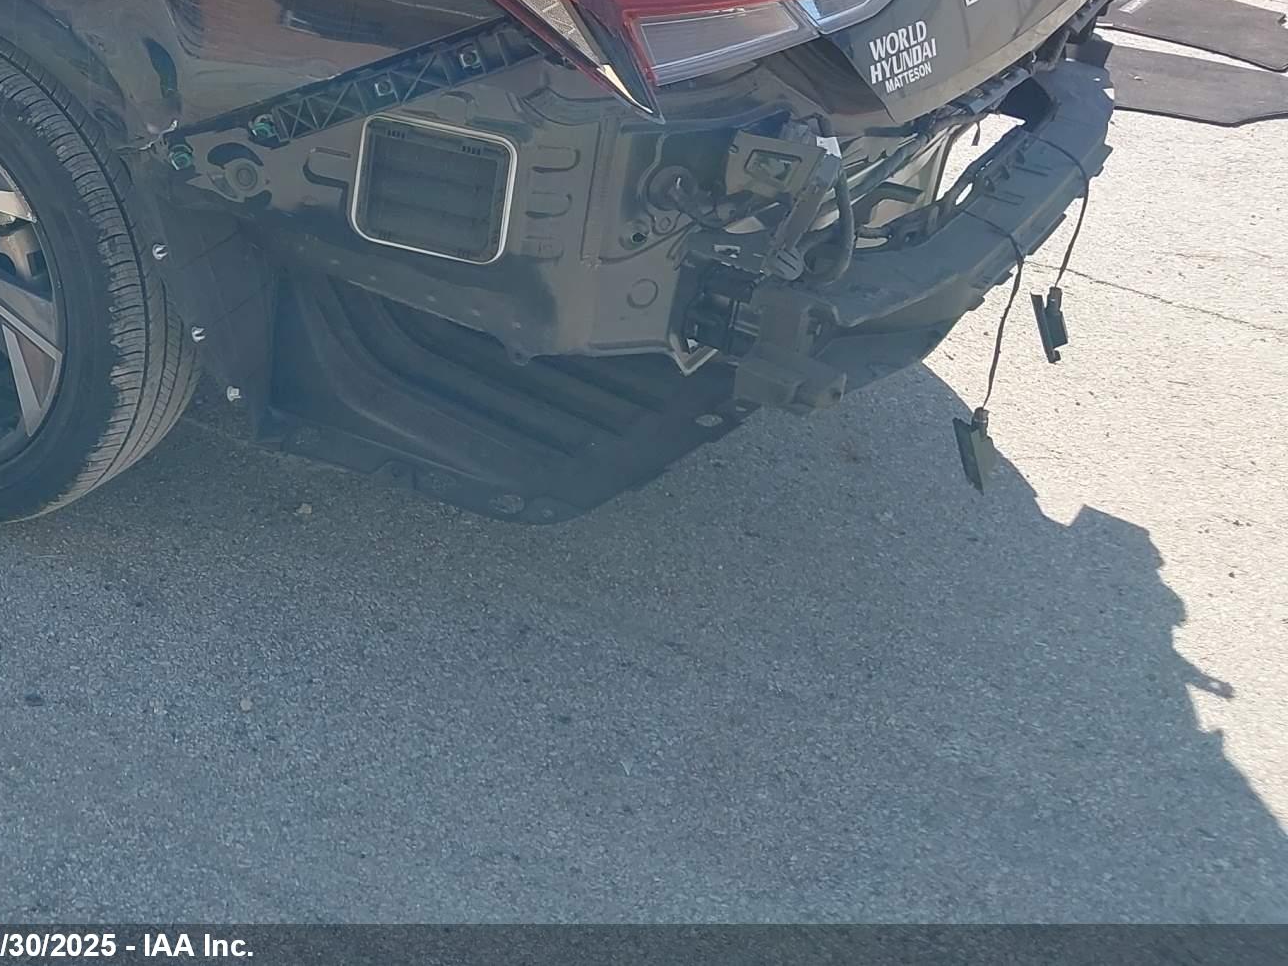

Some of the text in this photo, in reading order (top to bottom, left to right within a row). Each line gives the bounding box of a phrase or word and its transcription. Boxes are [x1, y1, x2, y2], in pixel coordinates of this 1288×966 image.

[869, 20, 927, 61] WORLD
[870, 38, 937, 84] HYUNDAI
[885, 61, 932, 94] MATTESON
